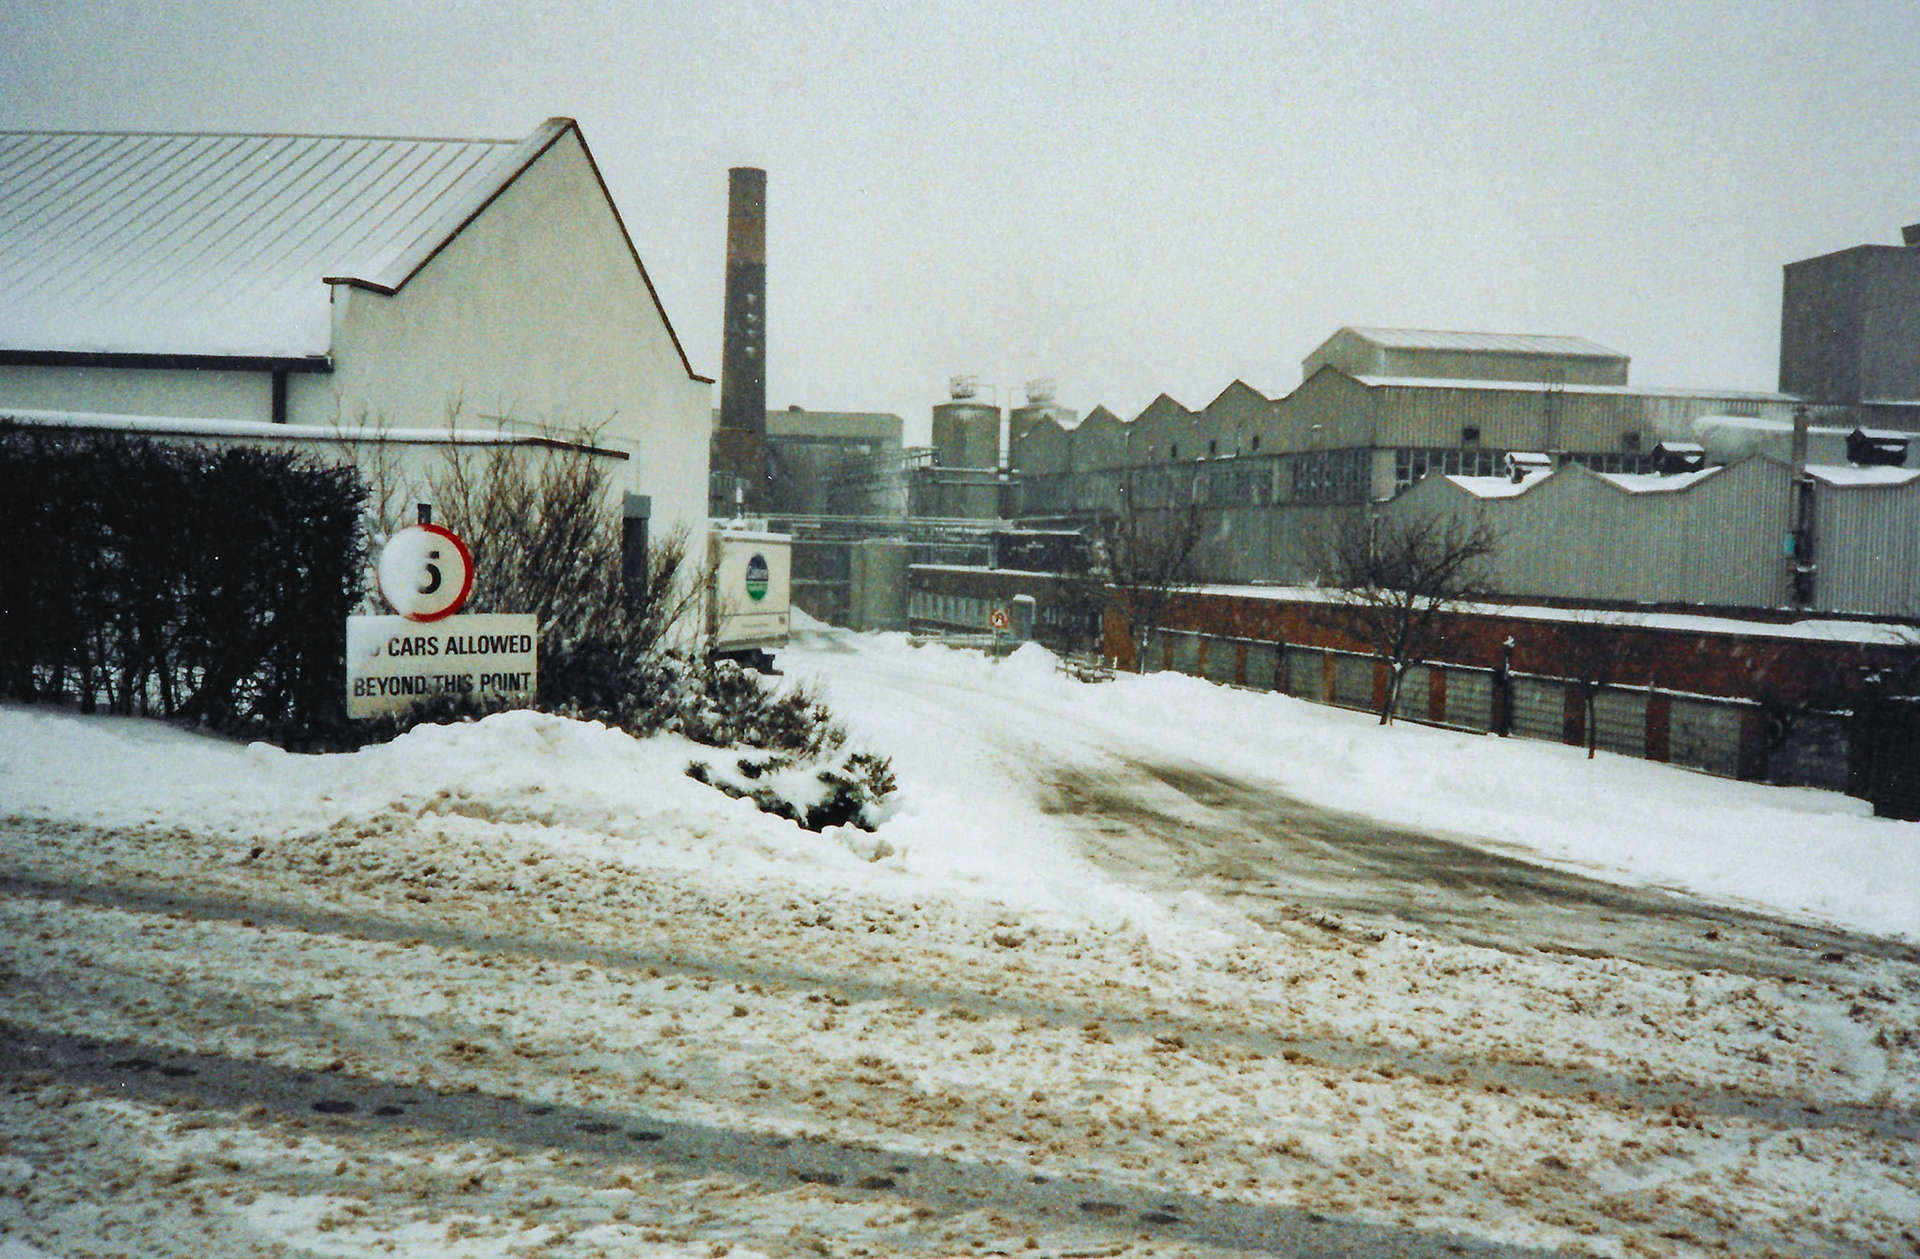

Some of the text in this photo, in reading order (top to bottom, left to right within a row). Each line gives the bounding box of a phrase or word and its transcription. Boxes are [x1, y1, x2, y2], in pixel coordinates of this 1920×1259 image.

[416, 550, 442, 594] 5
[387, 636, 439, 657] CARS
[444, 635, 532, 655] ALLOWED
[353, 672, 532, 697] BEYOND THIS POINT
